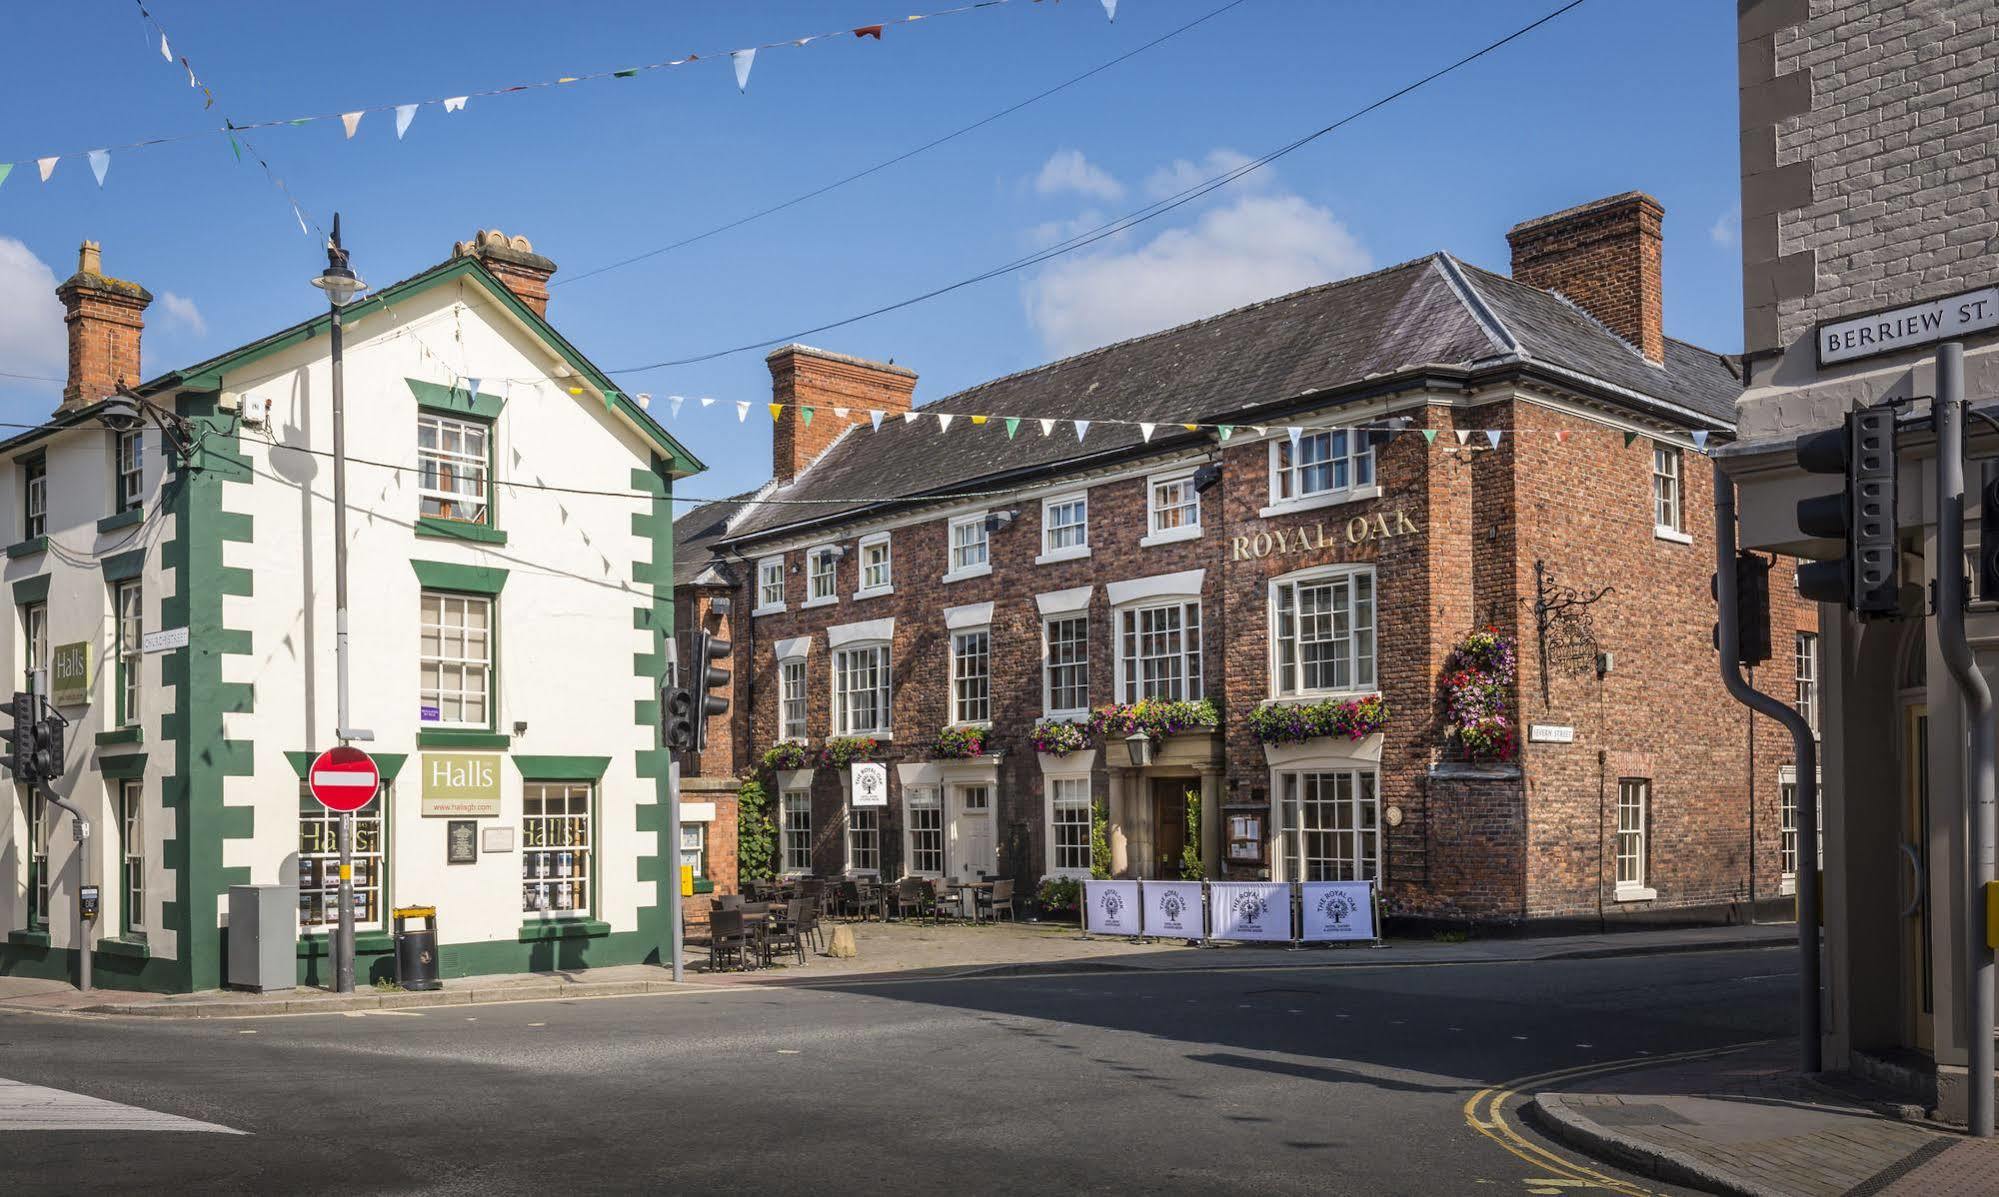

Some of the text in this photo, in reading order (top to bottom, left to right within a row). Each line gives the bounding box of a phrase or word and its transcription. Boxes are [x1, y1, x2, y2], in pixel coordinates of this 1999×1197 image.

[1828, 300, 1993, 352] BERRIEW ST.
[1231, 506, 1419, 561] ROYAL OAK
[57, 648, 84, 679] Halls
[432, 760, 494, 787] Halls
[300, 822, 368, 851] Hals
[1104, 889, 1118, 897] ROYAL
[1164, 889, 1179, 897] ROYAL
[1232, 891, 1269, 913] THE ROYAL OAK
[1317, 890, 1357, 912] THE ROYAL OAK
